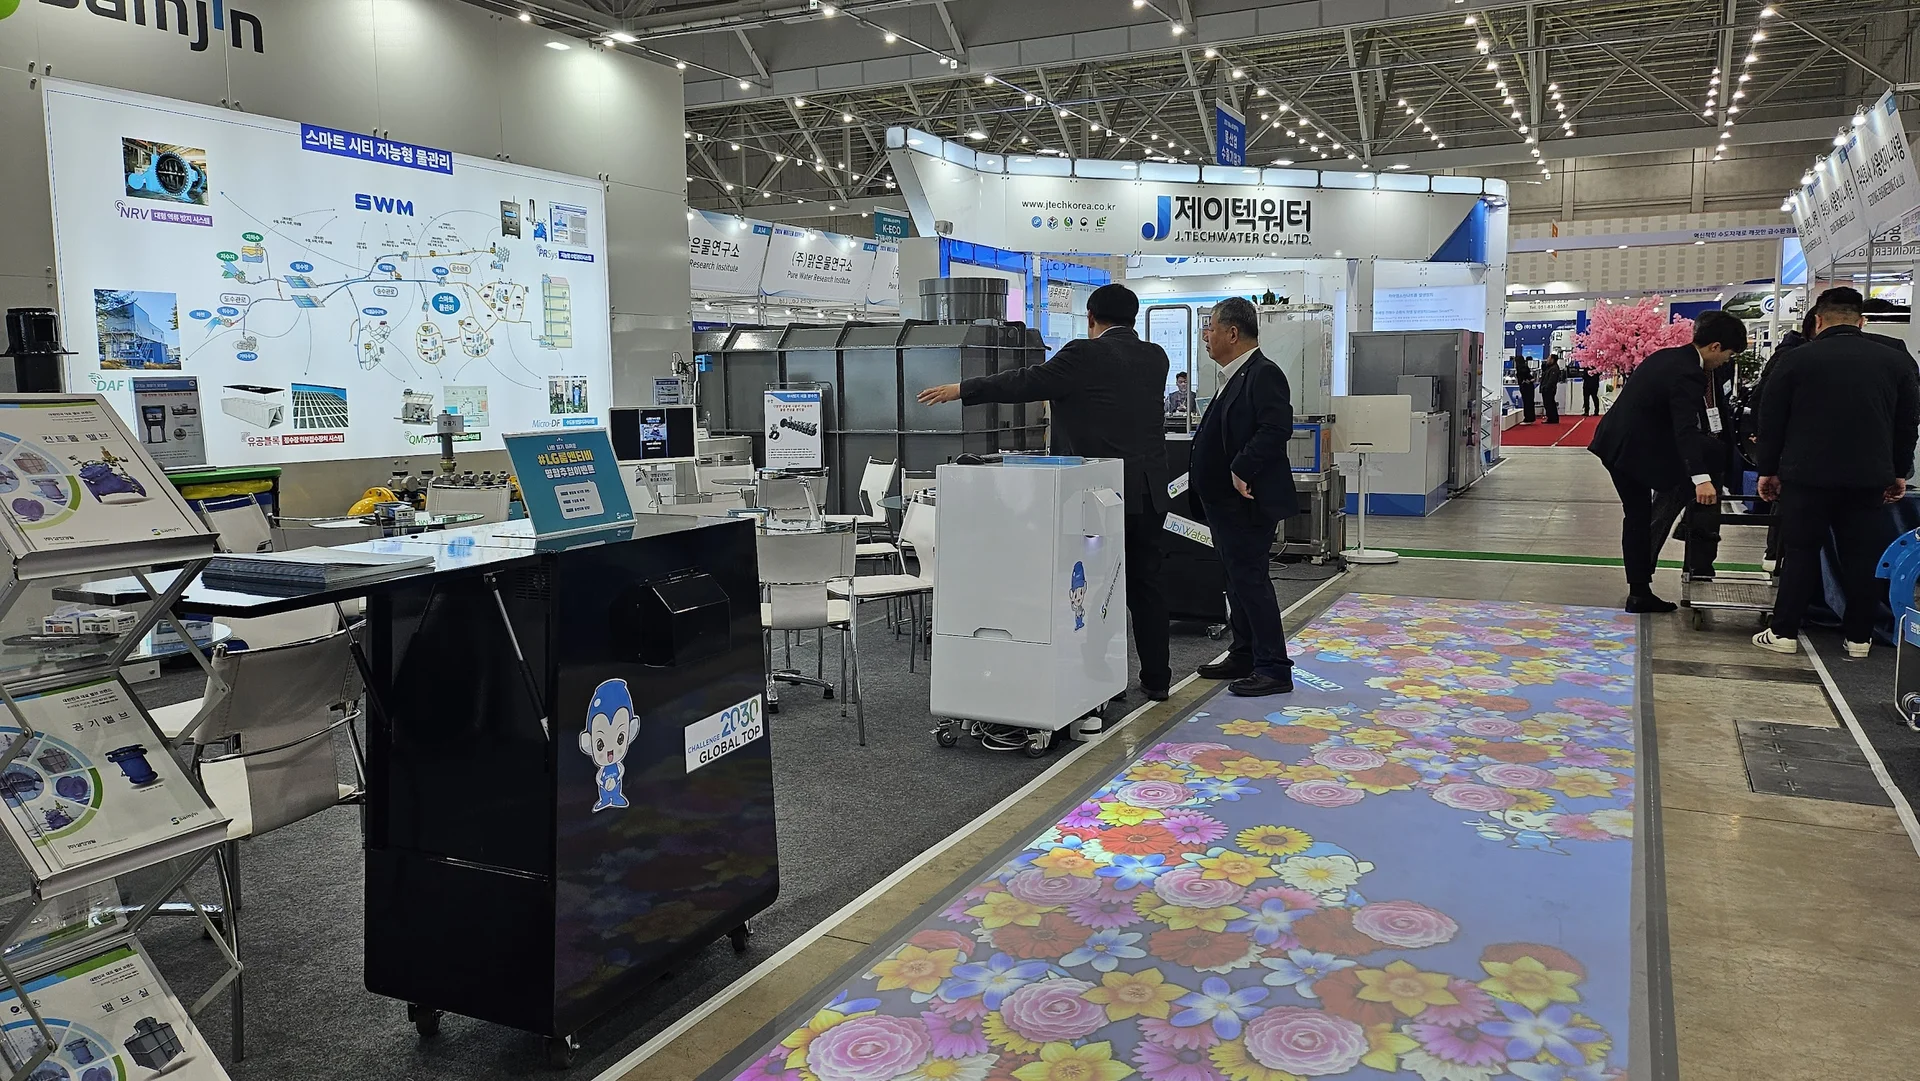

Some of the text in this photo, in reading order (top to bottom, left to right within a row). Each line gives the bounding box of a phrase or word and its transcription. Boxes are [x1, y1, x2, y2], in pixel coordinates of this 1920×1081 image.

[305, 130, 450, 171] 스마트 시티 지능형 물관리
[354, 193, 414, 217] SWM
[1022, 199, 1116, 212] www.jtechkorea.co.kr
[120, 207, 149, 220] NRV
[192, 215, 210, 224] 시스템
[1174, 196, 1312, 234] 제이텍워터
[1174, 230, 1260, 244] J.TECHWATER
[716, 262, 739, 272] Institute
[787, 270, 798, 279] Pure
[800, 272, 814, 281] Water
[96, 380, 124, 392] DAF
[247, 436, 280, 447] 유공블록
[720, 698, 758, 738] 2030
[688, 733, 720, 754] CHALLENGE
[700, 725, 760, 764] GLOBAL TOP
